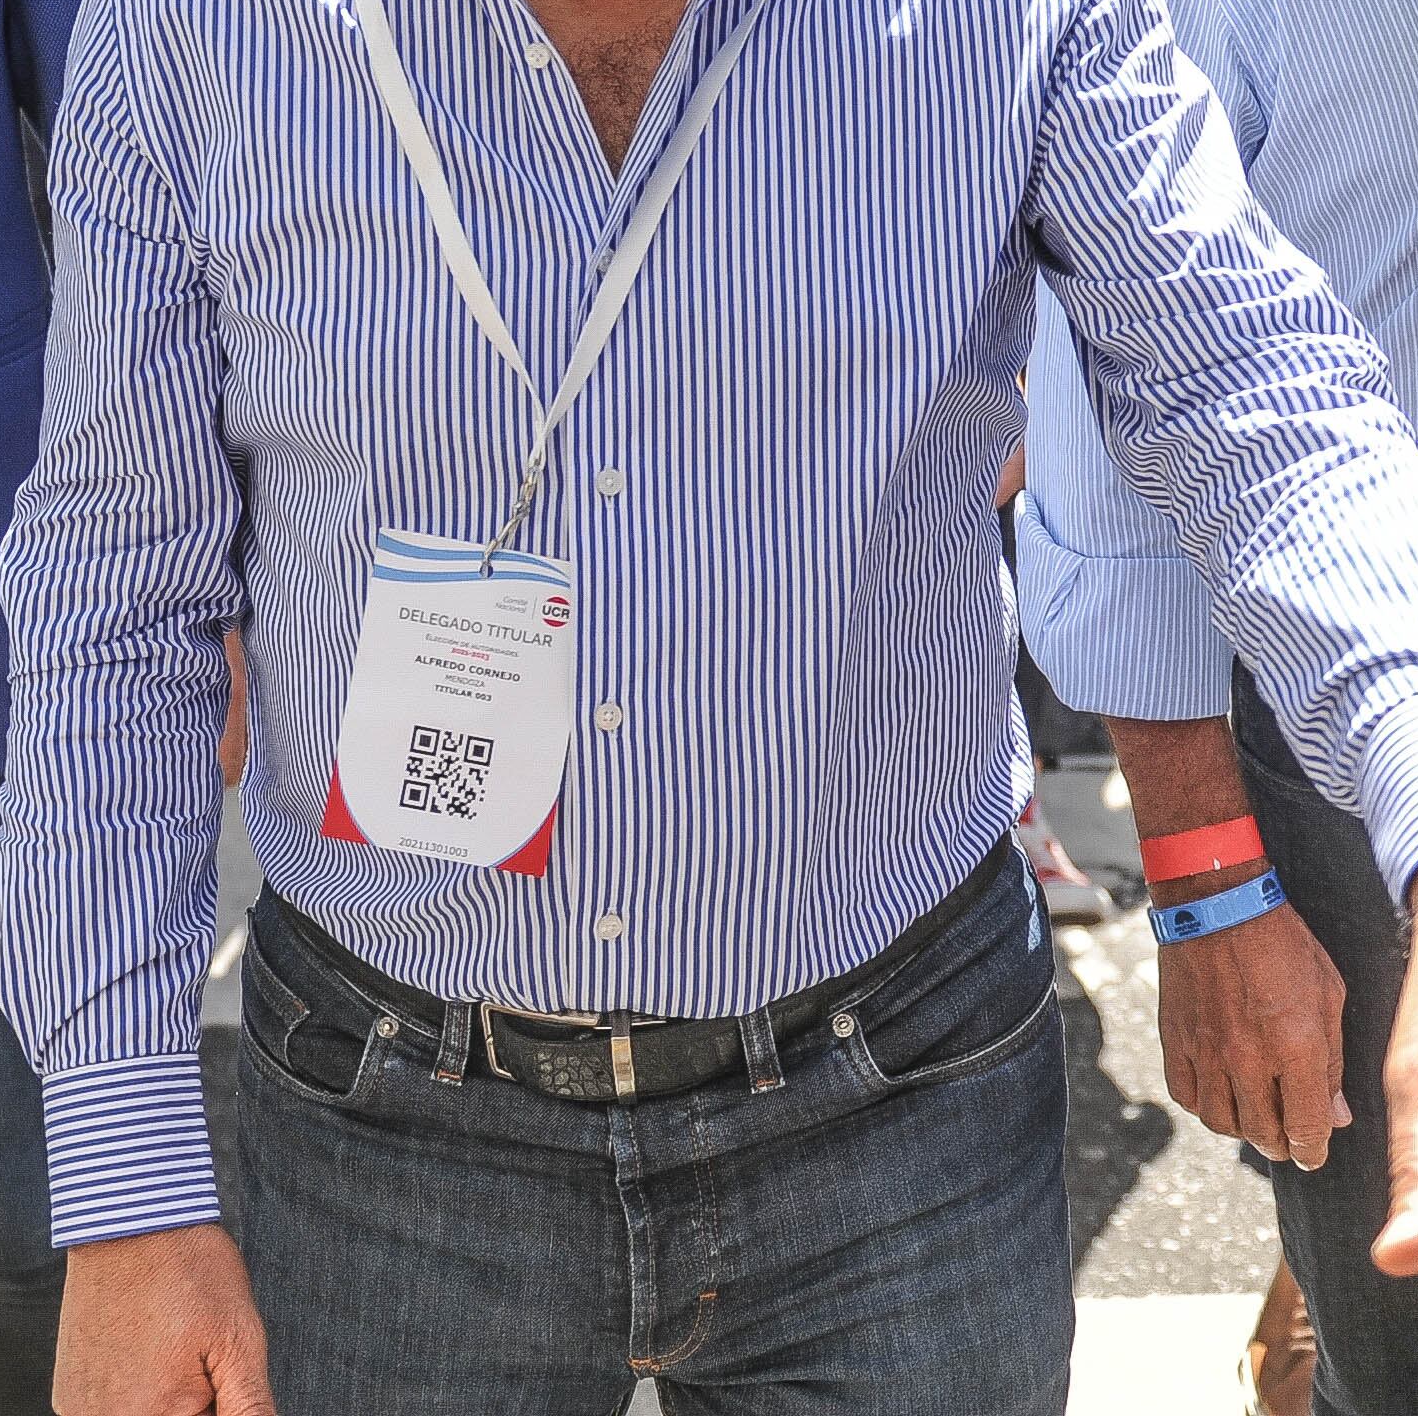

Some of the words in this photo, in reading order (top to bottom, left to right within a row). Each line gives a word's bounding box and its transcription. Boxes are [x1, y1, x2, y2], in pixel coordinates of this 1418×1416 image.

[542, 604, 570, 620] UCR
[399, 607, 483, 634] DELEGADO
[487, 623, 553, 647] TITULAR
[415, 655, 466, 672] ALFREDO
[468, 665, 521, 683] CORNEJO
[445, 674, 485, 688] MENDOZA
[435, 684, 472, 698] TITULAR
[474, 692, 492, 702] 003
[398, 836, 468, 858] 20211301003
